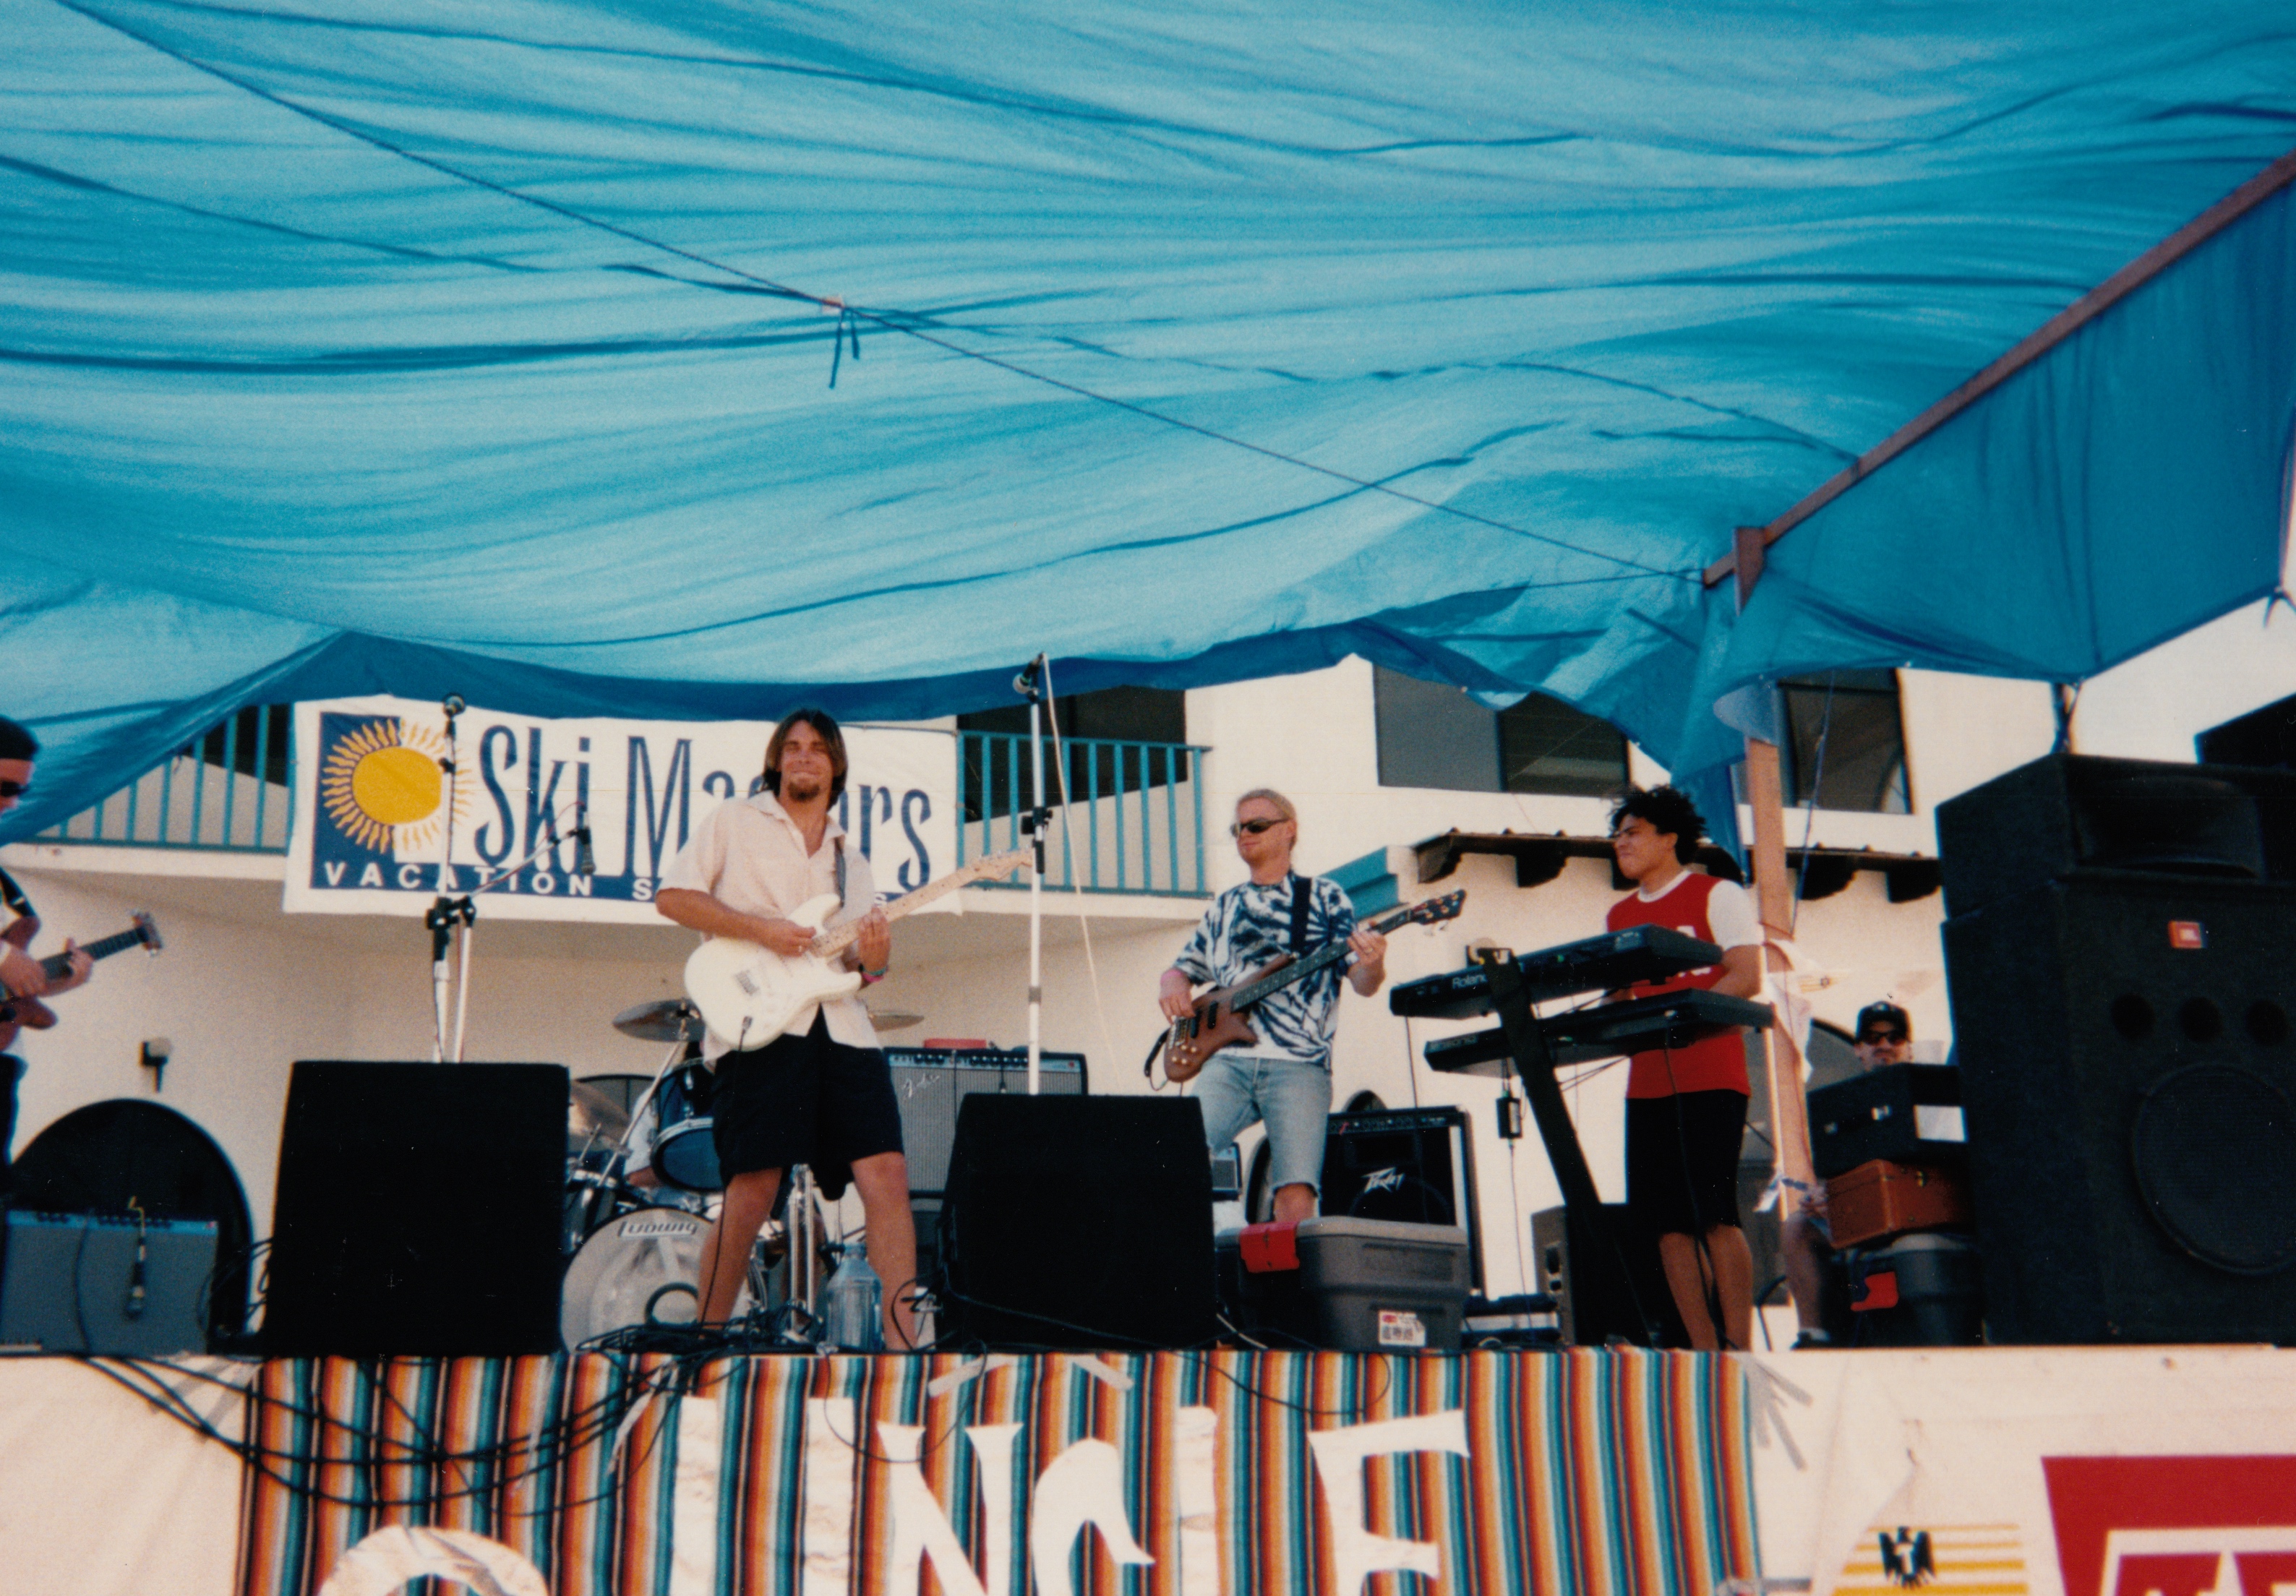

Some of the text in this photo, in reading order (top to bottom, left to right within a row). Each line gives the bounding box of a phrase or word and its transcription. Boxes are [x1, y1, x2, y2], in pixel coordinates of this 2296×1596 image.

[474, 724, 591, 874] Ski
[324, 862, 592, 896] VACATION
[1452, 973, 1488, 990] Rolan
